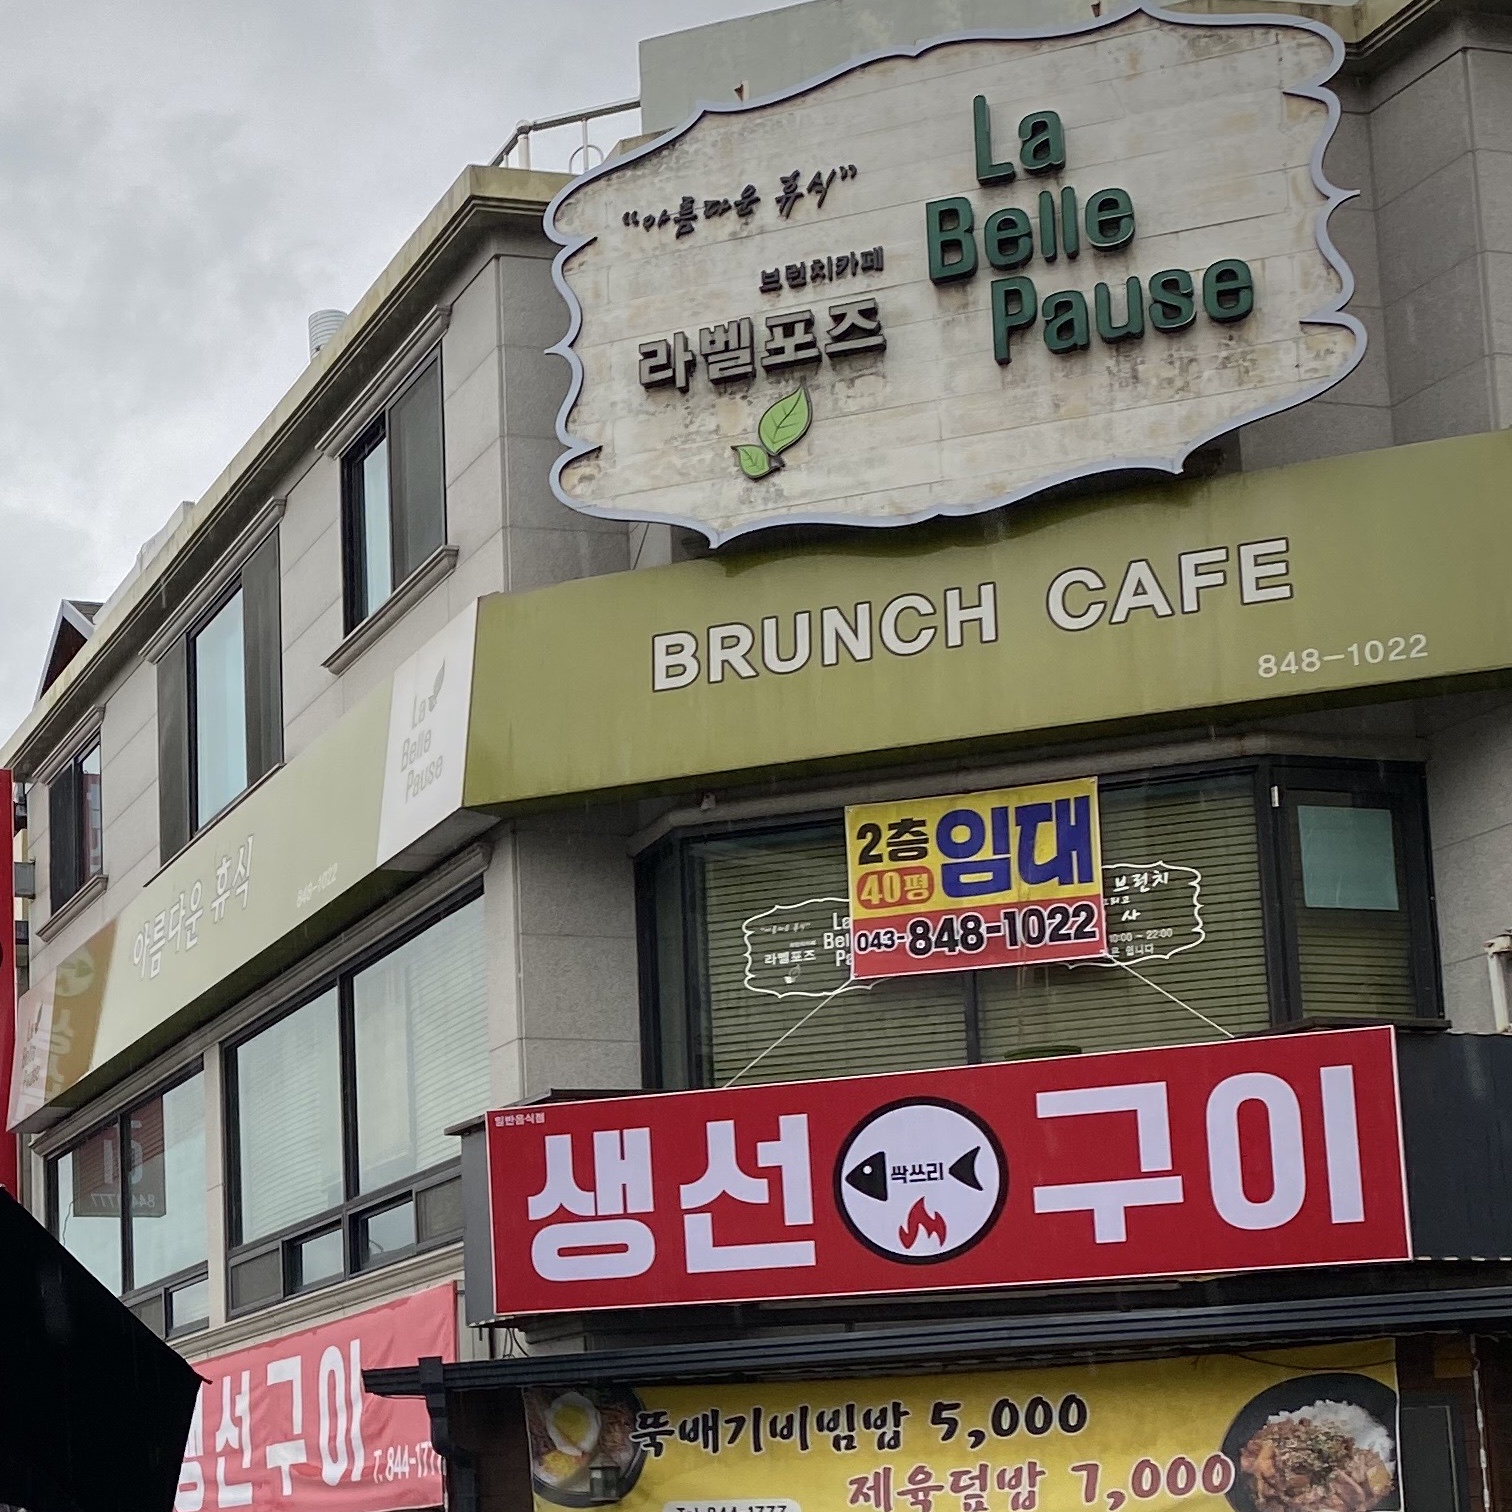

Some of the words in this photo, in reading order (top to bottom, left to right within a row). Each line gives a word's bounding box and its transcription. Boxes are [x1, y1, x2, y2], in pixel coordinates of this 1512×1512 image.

[973, 94, 1066, 187] La
[926, 186, 1136, 286] Belle
[759, 246, 885, 293] 브런치카페
[991, 259, 1254, 365] Pause
[639, 297, 887, 393] 라벨포즈
[652, 582, 998, 692] BRUNCH
[1047, 537, 1292, 632] CAFE
[1258, 634, 1429, 678] 848-1022
[412, 694, 426, 730] La
[401, 730, 432, 772] Belle
[406, 755, 443, 804] Pause
[857, 817, 929, 865] 2층
[936, 795, 1094, 898] 임대
[133, 879, 204, 979] 아름다운
[211, 833, 254, 923] 휴식
[861, 871, 929, 905] 40평
[1113, 870, 1169, 892] 브런치
[856, 903, 1097, 958] 043-848-1022
[1146, 928, 1173, 940] 22:00
[764, 950, 816, 965] 라벨포즈
[528, 1113, 816, 1282] 생선
[1034, 1064, 1365, 1244] 구이
[891, 1162, 944, 1184] 싹쓰리
[631, 1401, 911, 1457] 뚝배기비빔밥
[930, 1394, 1087, 1449] 5,000
